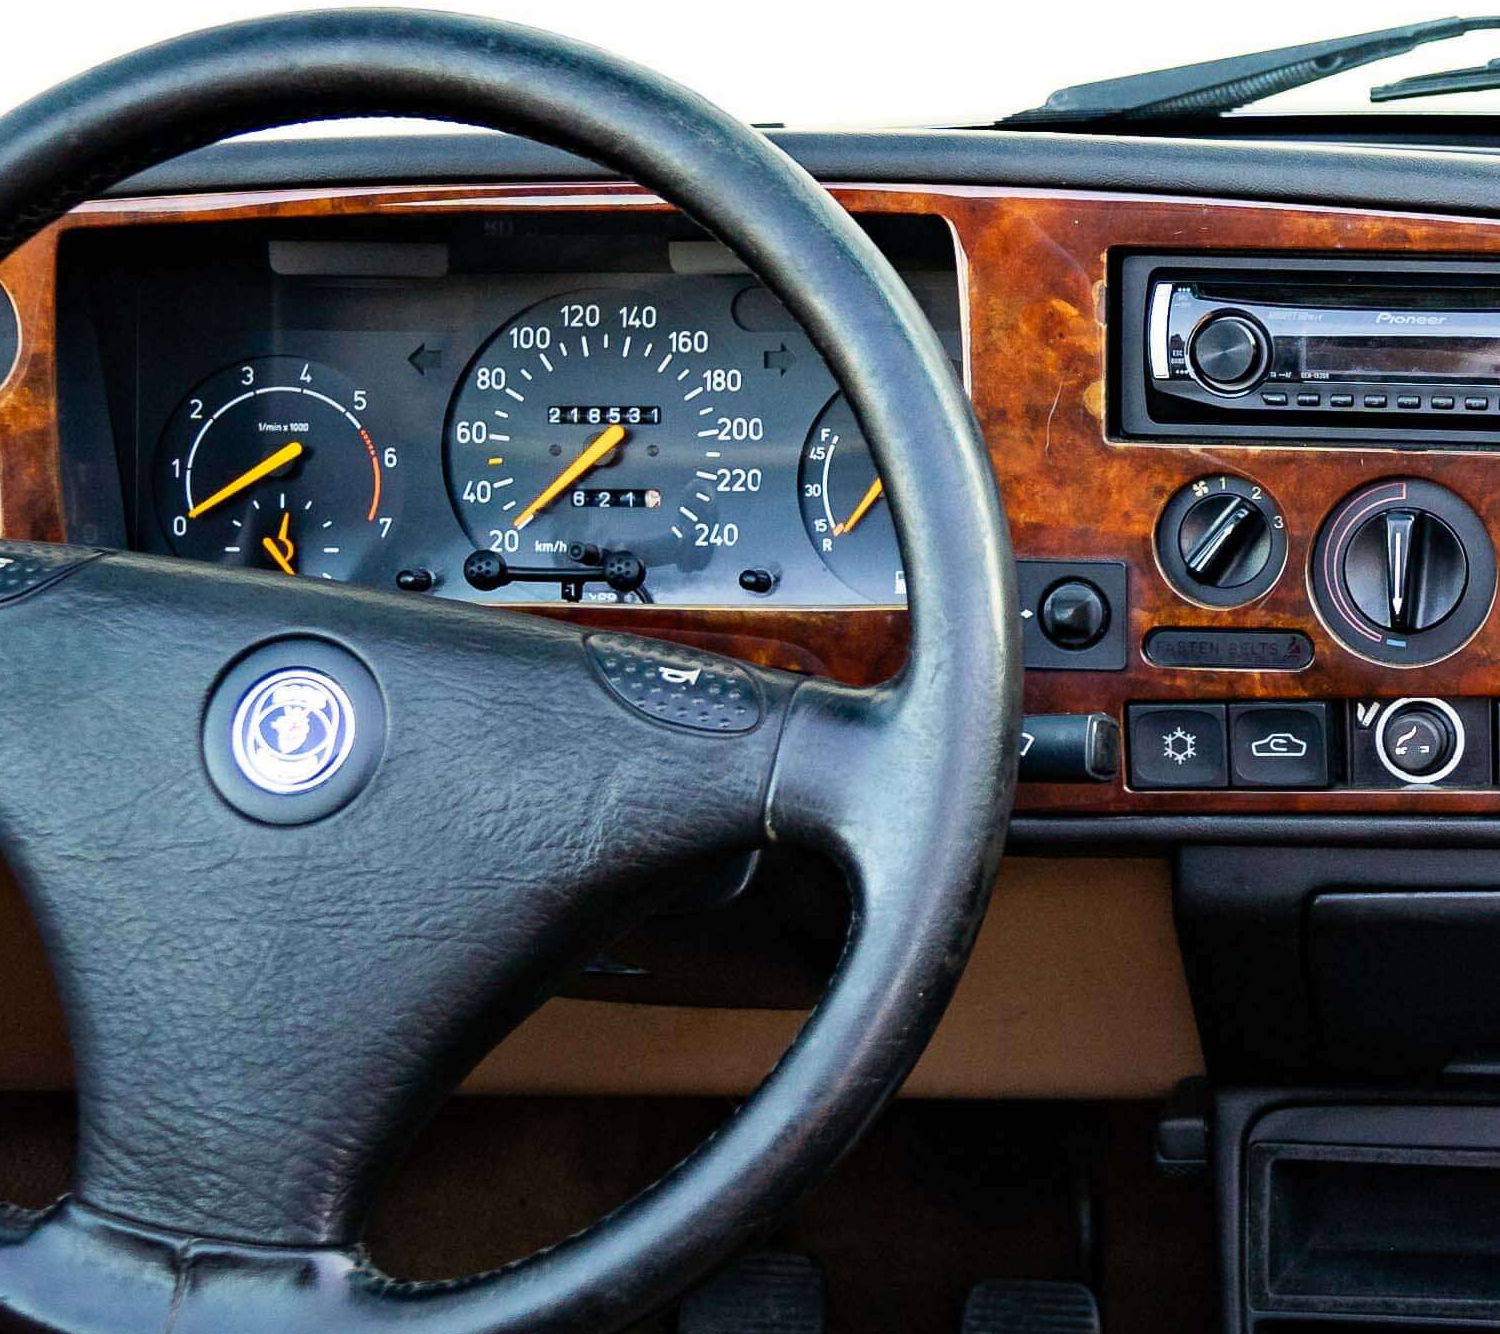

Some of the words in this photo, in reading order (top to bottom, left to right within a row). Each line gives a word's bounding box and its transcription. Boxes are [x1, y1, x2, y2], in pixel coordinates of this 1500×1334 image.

[560, 304, 600, 327] 120
[619, 305, 657, 329] 140
[1376, 312, 1447, 325] Pioneer
[509, 327, 551, 350] 100
[668, 330, 709, 354] 160
[241, 365, 254, 386] 3
[299, 363, 313, 384] 4
[476, 367, 506, 390] 80
[703, 368, 742, 392] 180
[189, 398, 203, 419] 2
[353, 390, 367, 411] 5
[548, 407, 658, 424] 218531
[289, 422, 309, 432] 1000
[456, 420, 487, 444] 60
[716, 417, 764, 441] 200
[820, 427, 831, 442] F
[384, 447, 398, 468] 6
[809, 446, 826, 461] 45
[171, 458, 180, 478] 1
[716, 468, 762, 492] 220
[804, 483, 822, 498] 30
[1218, 476, 1227, 493] 1
[462, 480, 492, 504] 40
[1251, 486, 1263, 501] 2
[173, 515, 187, 537] 0
[379, 517, 393, 539] 7
[813, 518, 828, 533] 15
[1273, 514, 1285, 530] 3
[489, 529, 520, 554] 20
[694, 522, 740, 547] 240
[822, 538, 833, 552] R
[534, 540, 568, 553] km/h
[1156, 641, 1220, 656] FASTEN
[1227, 642, 1279, 657] BELTS
